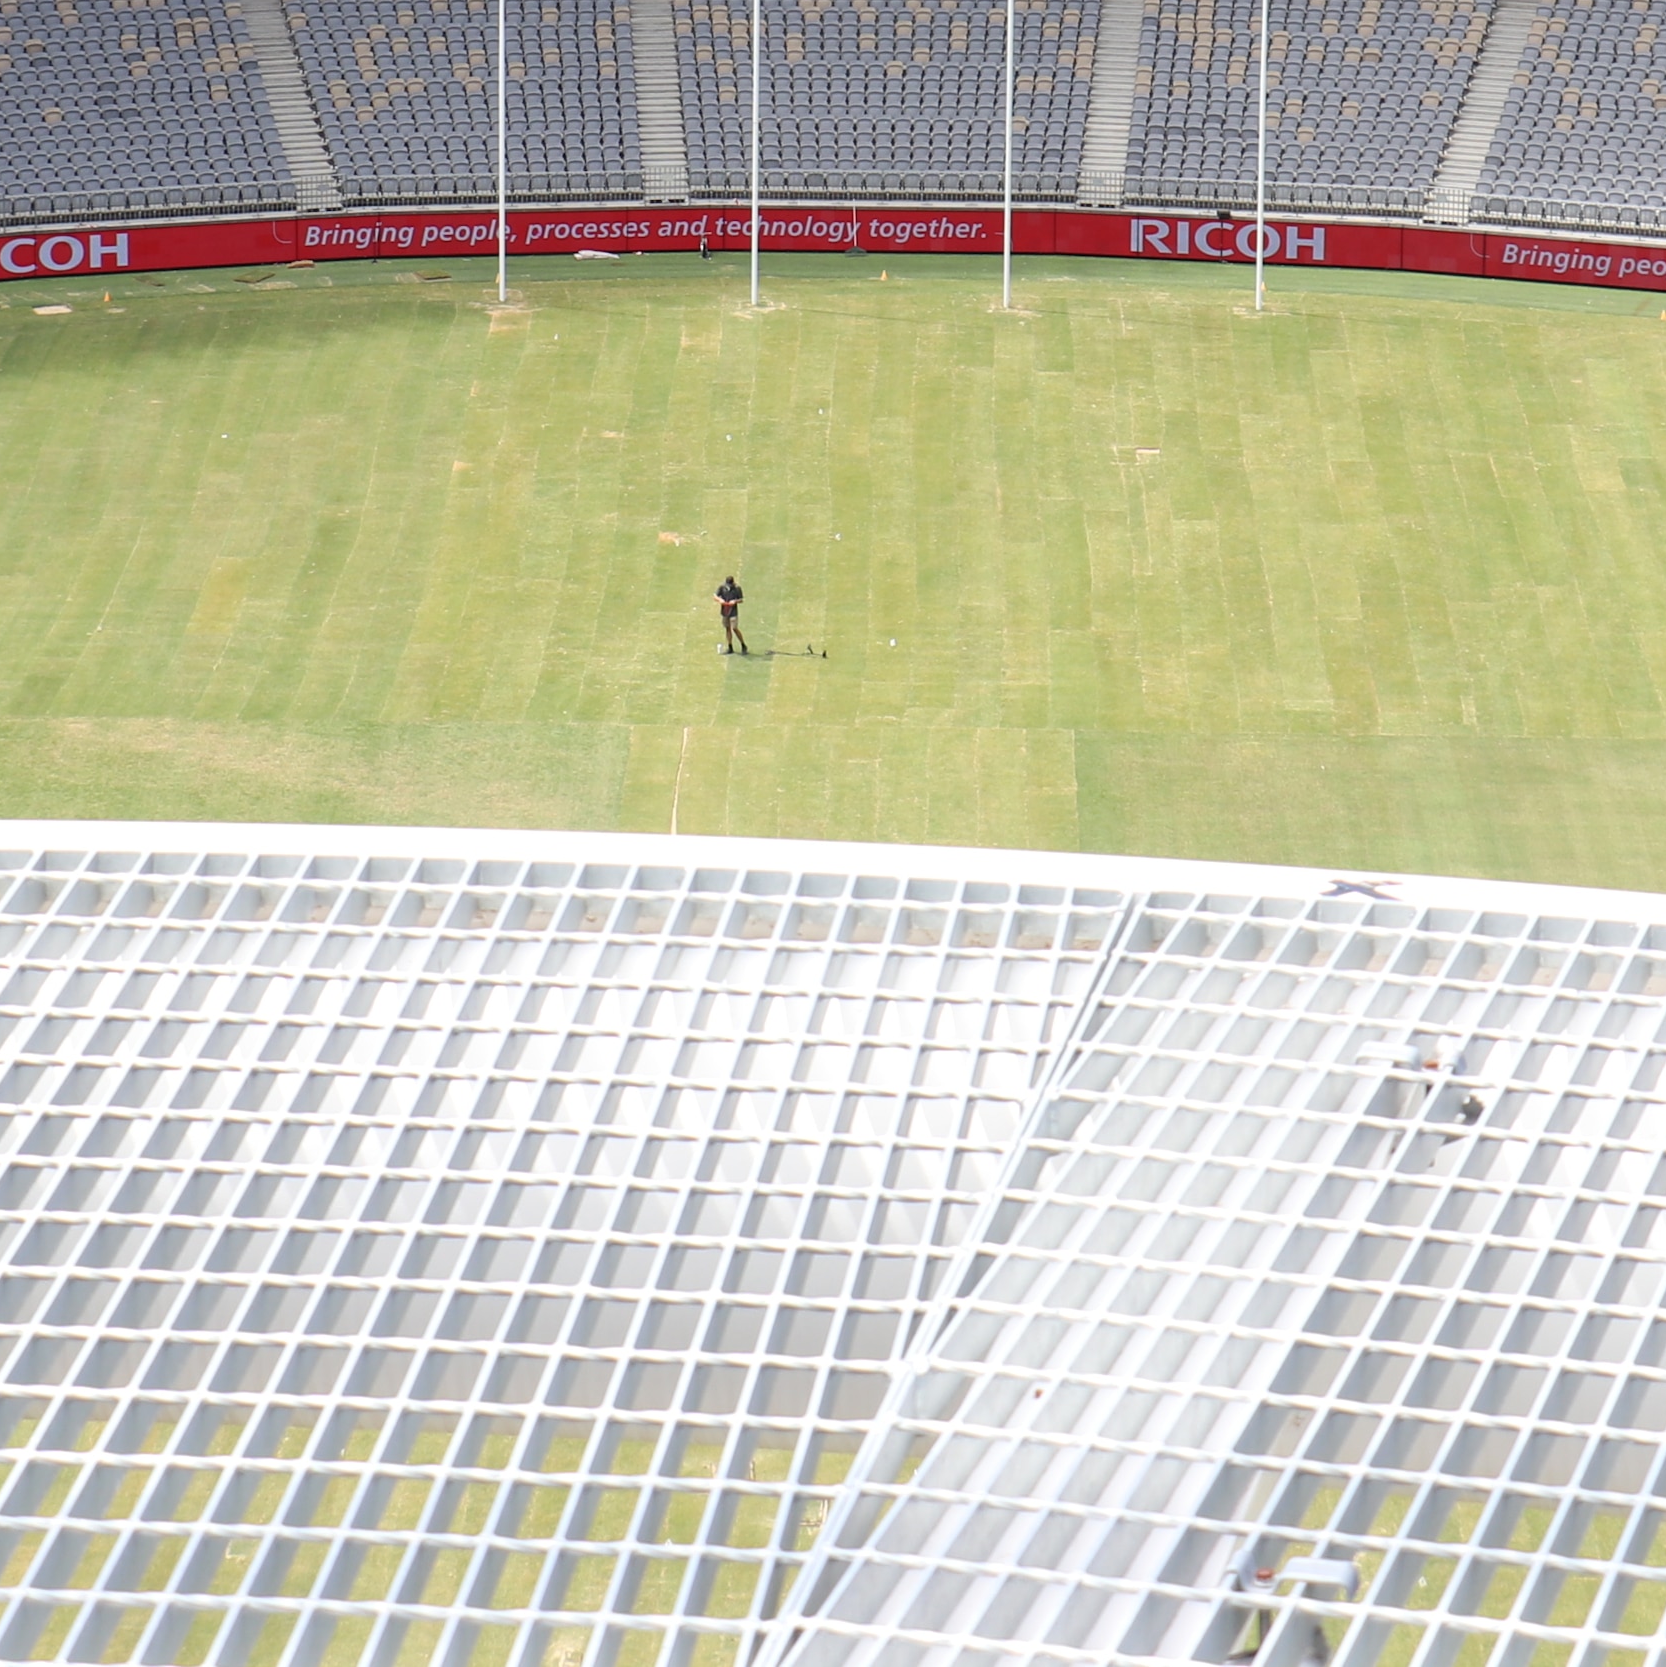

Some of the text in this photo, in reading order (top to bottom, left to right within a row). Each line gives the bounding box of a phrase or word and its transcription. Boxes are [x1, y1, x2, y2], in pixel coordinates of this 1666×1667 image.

[305, 222, 414, 249] Bringing
[526, 220, 650, 244] processes
[658, 217, 707, 238] and
[870, 217, 988, 244] together.
[1129, 218, 1326, 261] RICOH
[1503, 244, 1612, 275] Bringing
